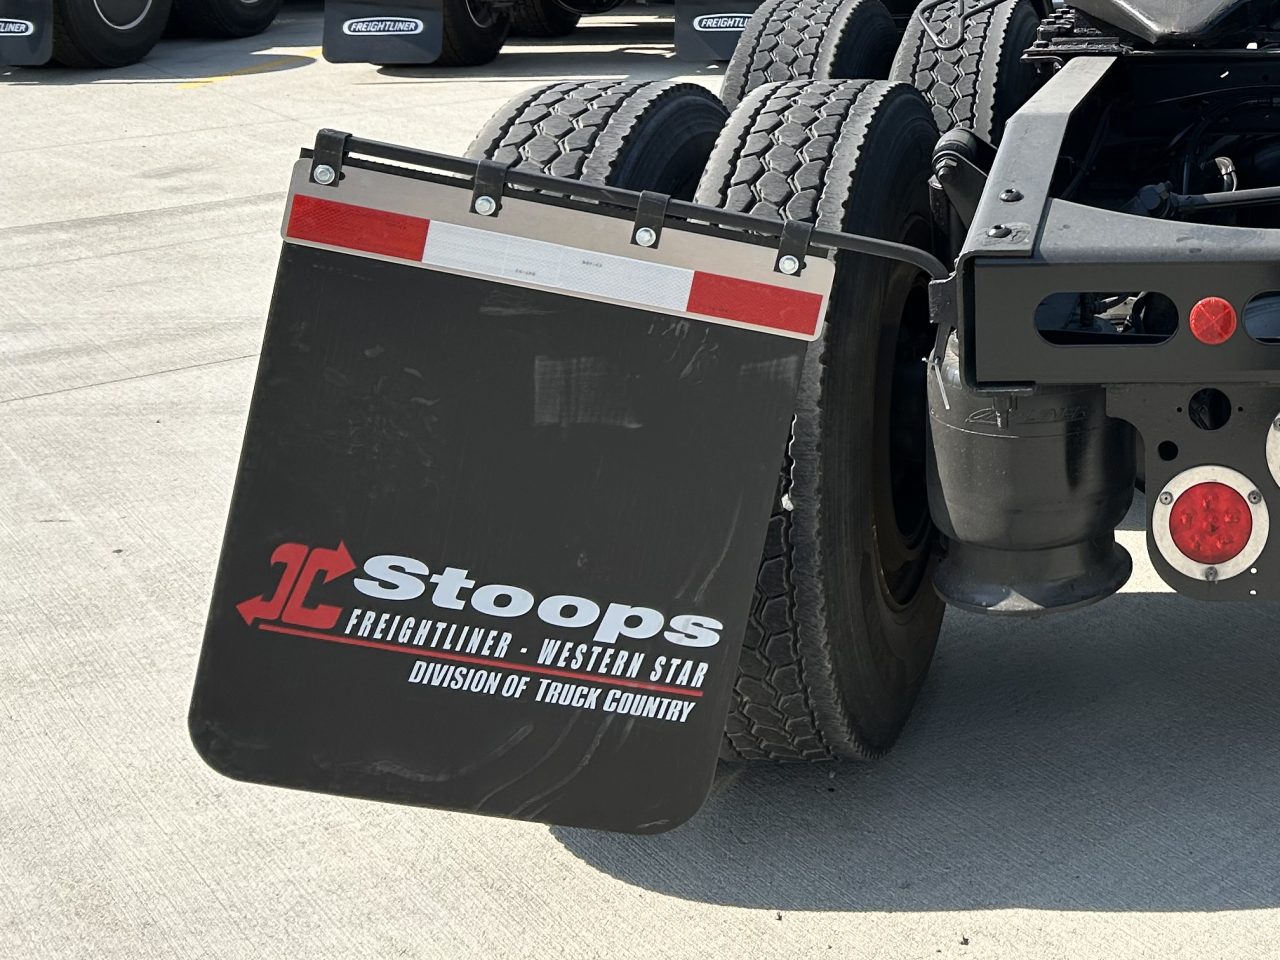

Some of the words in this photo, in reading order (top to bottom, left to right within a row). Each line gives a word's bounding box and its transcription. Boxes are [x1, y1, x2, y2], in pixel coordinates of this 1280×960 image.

[0, 22, 26, 32] LINER
[350, 21, 416, 32] FREIGHTLINER
[353, 554, 724, 648] Stoops
[344, 608, 513, 659] FREIGHTLINER
[536, 638, 646, 679] WESTERN
[649, 655, 709, 688] STAR
[407, 660, 502, 695] DIVISION
[502, 674, 531, 699] OF
[535, 678, 603, 710] TRUCK
[602, 688, 697, 723] COUNTRY
